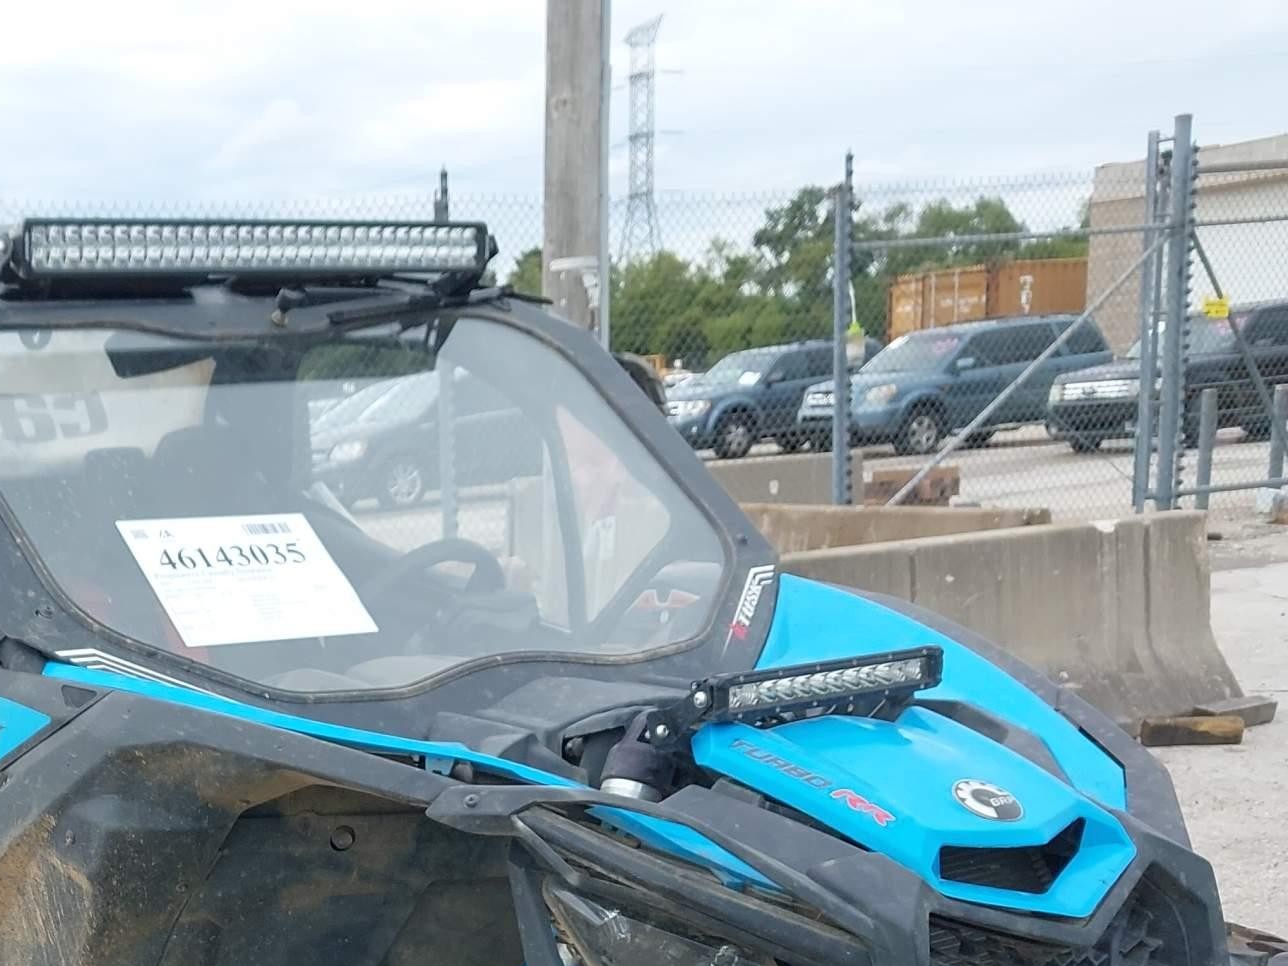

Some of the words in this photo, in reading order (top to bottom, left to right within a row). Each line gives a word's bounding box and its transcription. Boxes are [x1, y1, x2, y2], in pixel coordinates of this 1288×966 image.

[159, 541, 306, 570] 46143035
[738, 584, 763, 627] TUSK
[729, 738, 833, 790] TURBO
[831, 788, 896, 827] RR
